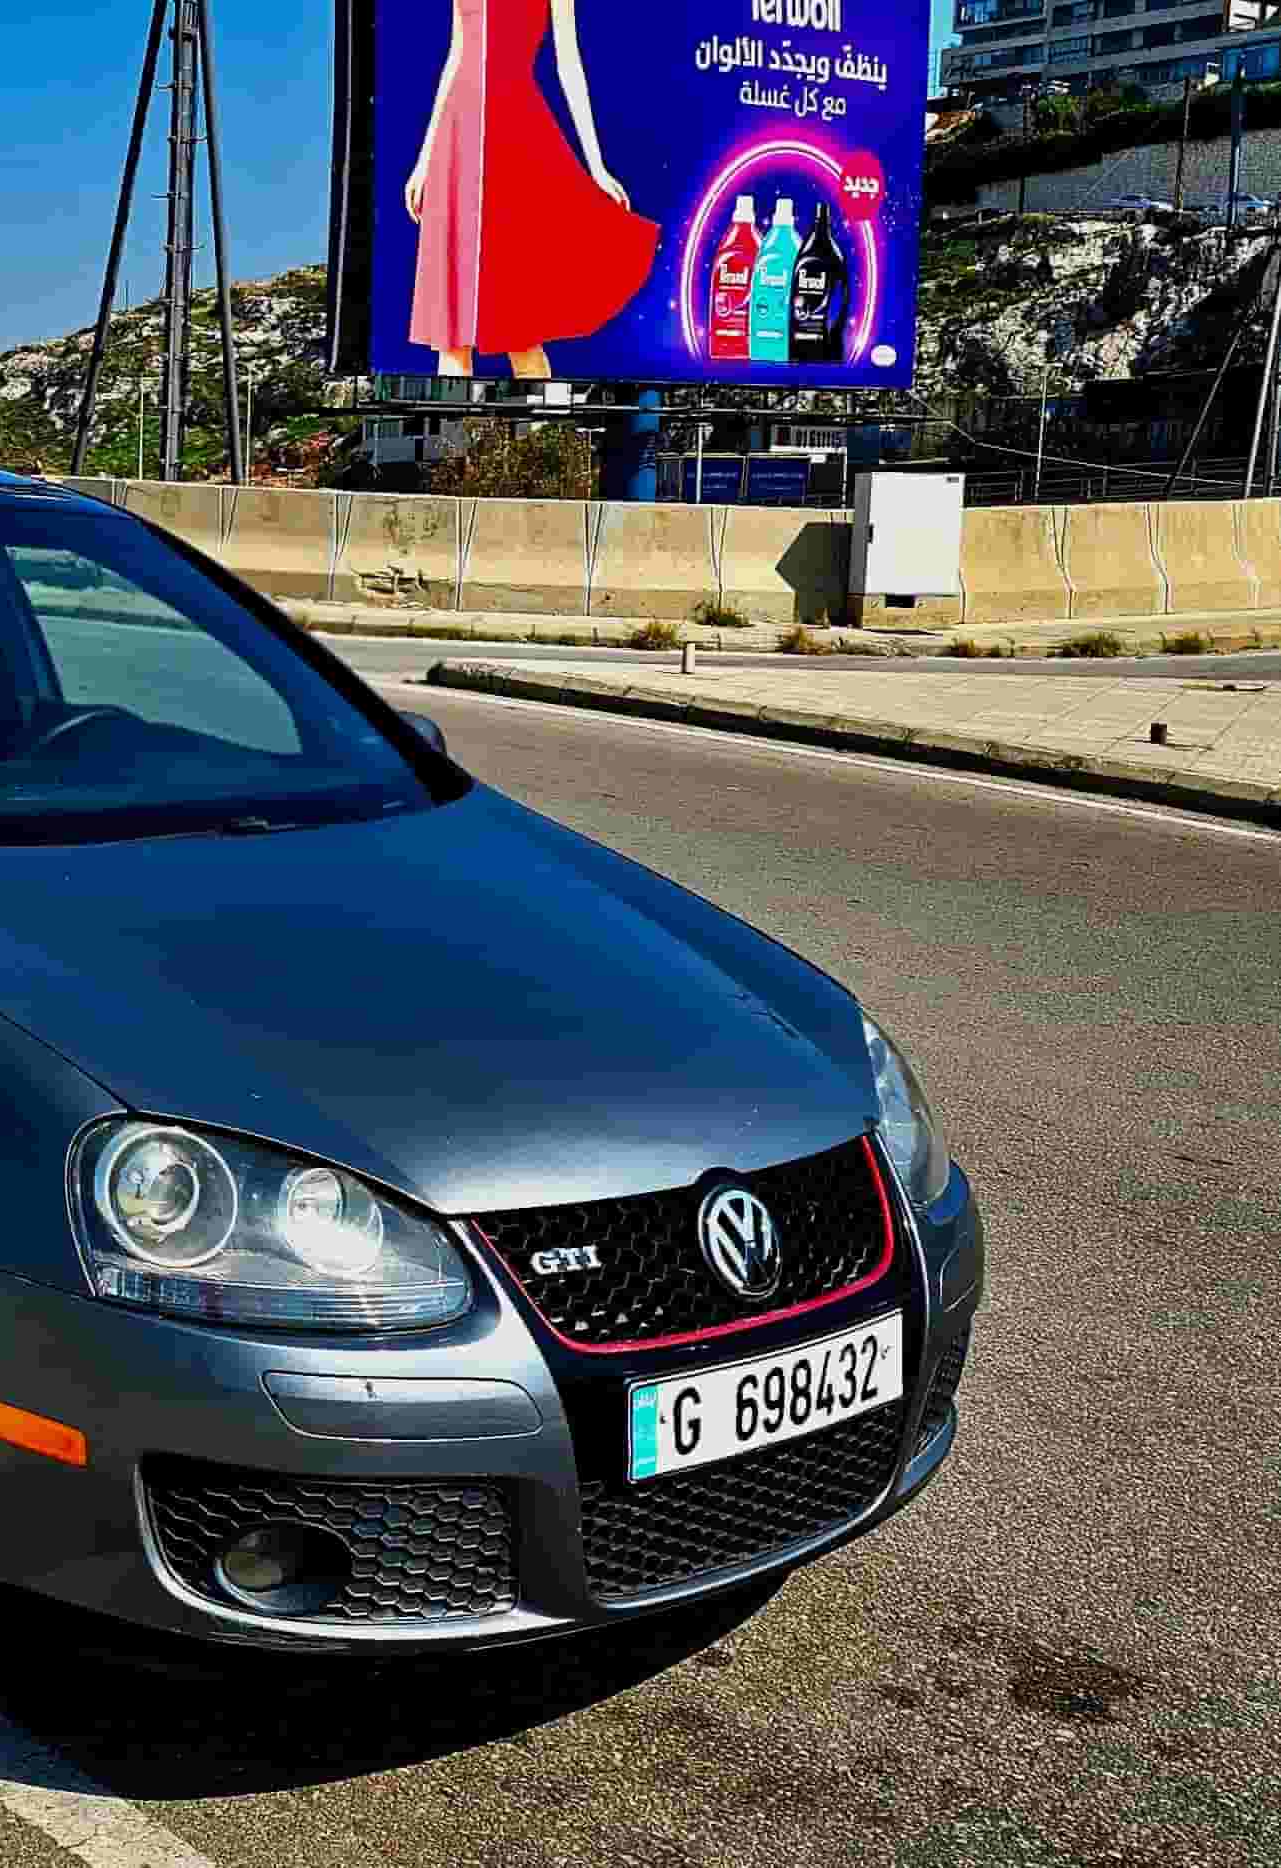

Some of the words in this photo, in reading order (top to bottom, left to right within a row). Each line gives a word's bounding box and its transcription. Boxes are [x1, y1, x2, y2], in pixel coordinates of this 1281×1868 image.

[695, 34, 763, 73] الألوان
[739, 80, 791, 108] غسلة
[793, 87, 819, 117] كل
[822, 95, 847, 121] مع
[530, 1245, 602, 1276] GTI
[672, 1386, 703, 1456] G
[735, 1335, 879, 1441] 698432
